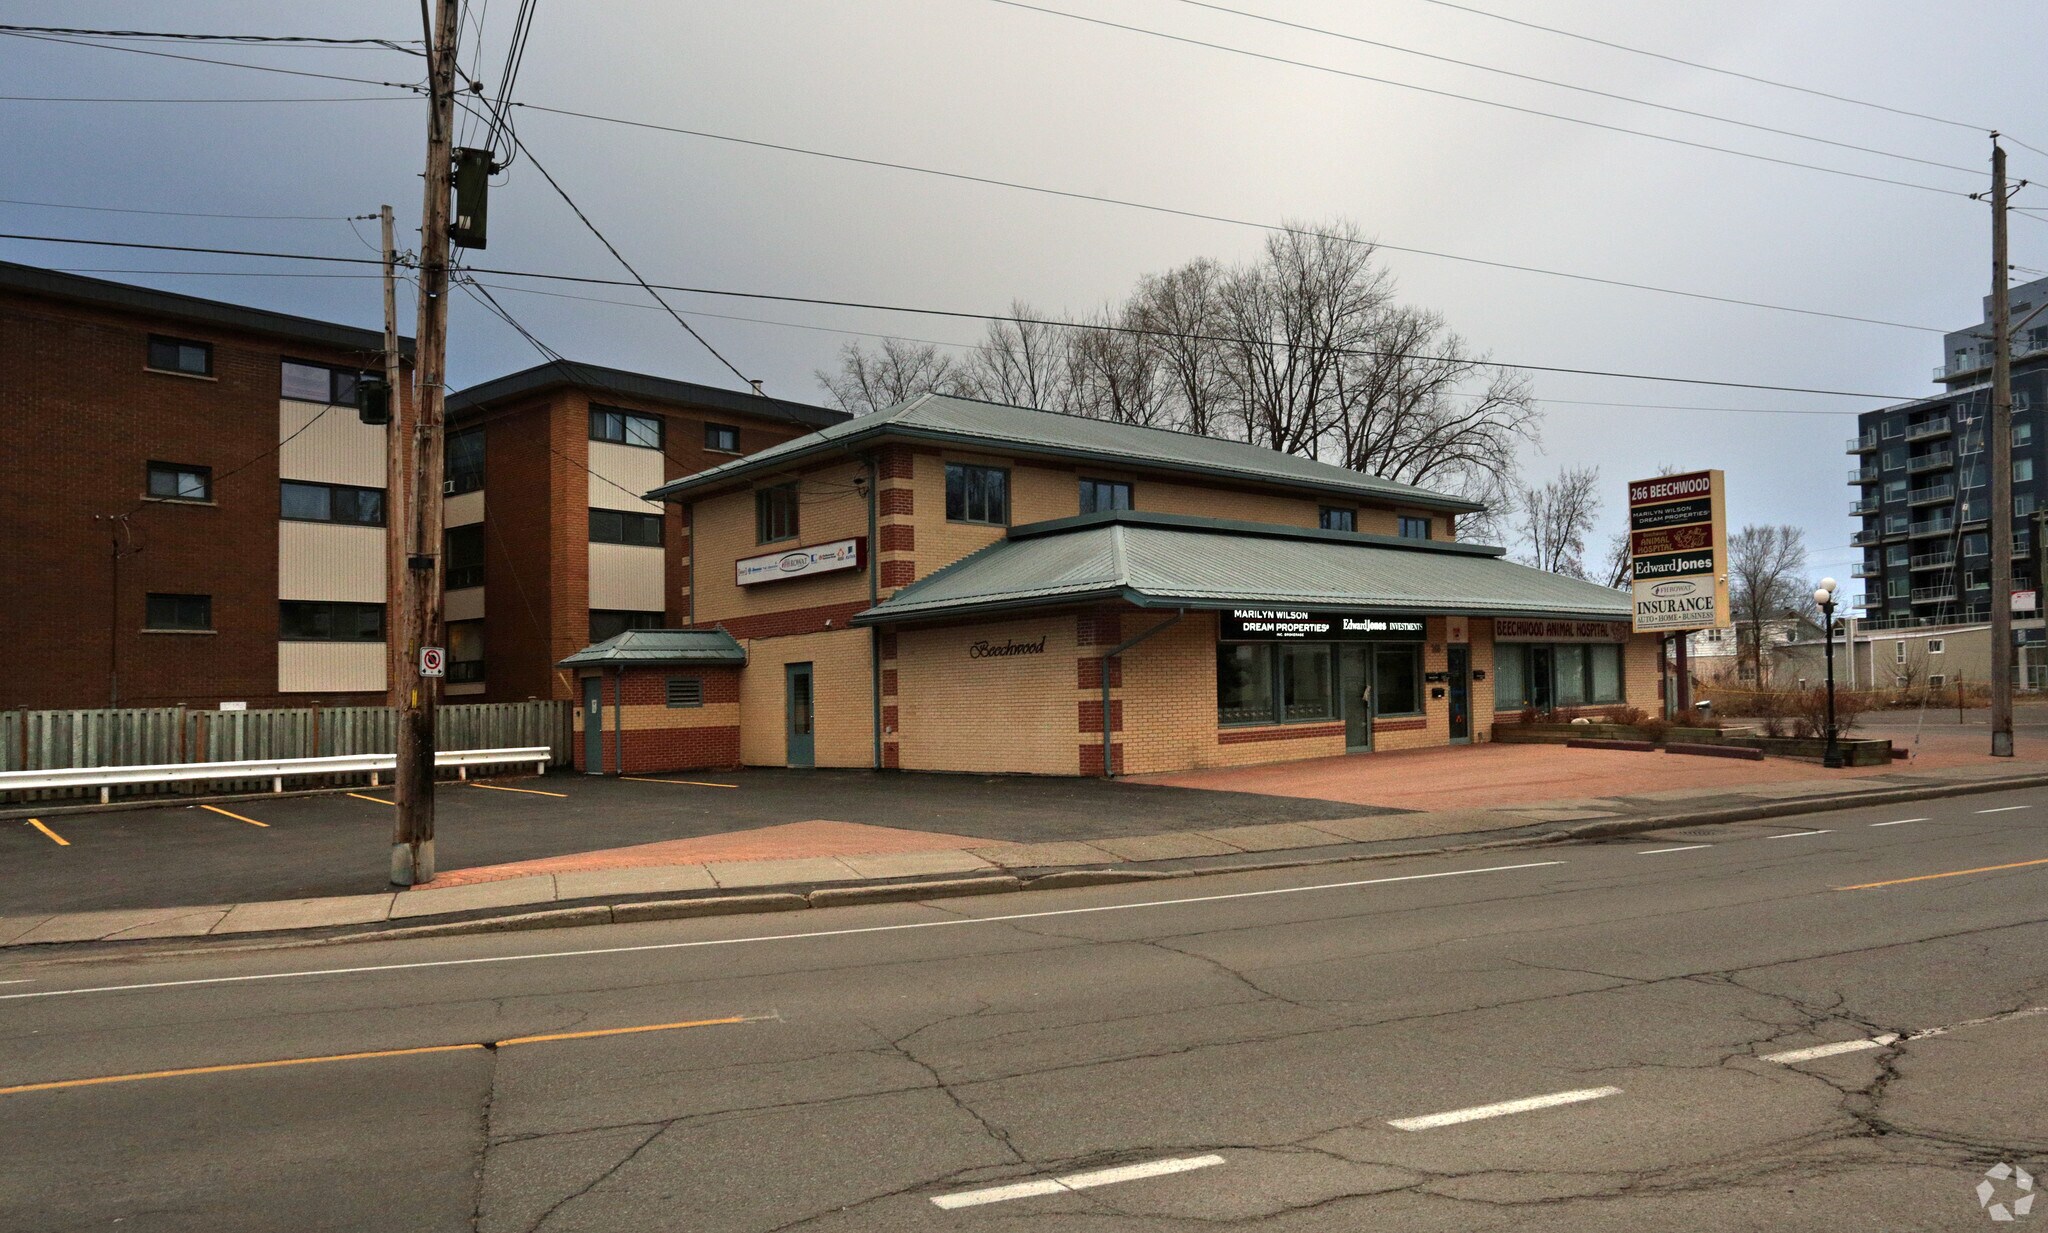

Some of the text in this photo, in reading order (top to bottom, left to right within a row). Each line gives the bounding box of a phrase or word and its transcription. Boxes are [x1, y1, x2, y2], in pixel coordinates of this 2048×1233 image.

[1631, 478, 1710, 500] 266 BEECHWOOD
[1632, 506, 1692, 518] MARILYN WILSON
[1640, 536, 1670, 546] ANIMAL
[1638, 544, 1674, 554] HOSPITAL
[1637, 596, 1714, 615] INSURANCE
[1234, 610, 1308, 620] MARILYN WILSON
[1637, 612, 1714, 623] AUTO HOME BUSINESS
[1243, 623, 1274, 631] DREAM
[1389, 622, 1423, 631] INVESTMENTS
[1496, 621, 1609, 638] BEECHWOOD ANIMAL HOSPITAL
[970, 635, 1046, 659] Beechwood
